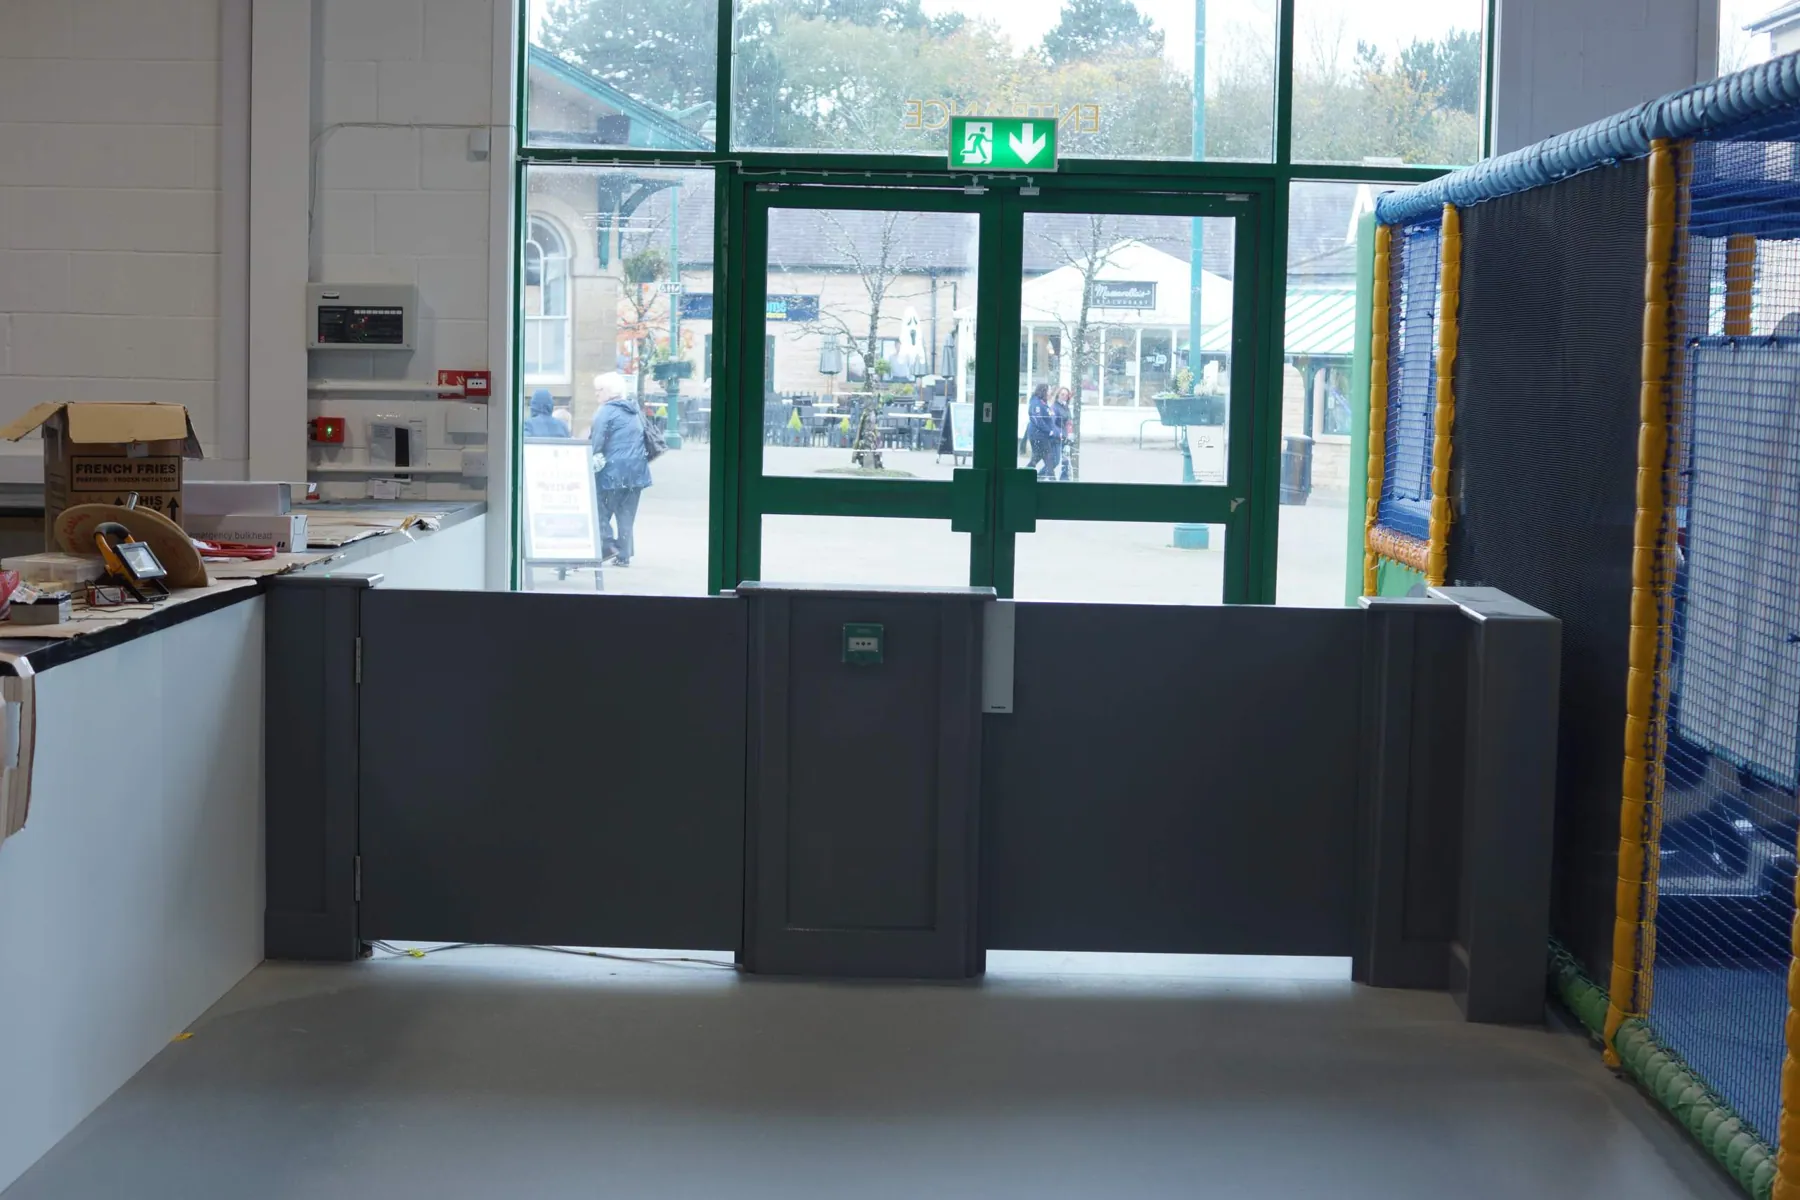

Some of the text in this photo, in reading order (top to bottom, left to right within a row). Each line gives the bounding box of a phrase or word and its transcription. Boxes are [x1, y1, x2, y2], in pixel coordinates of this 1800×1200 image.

[75, 463, 177, 475] FRENCH FRIES
[139, 495, 163, 506] HIS
[234, 530, 273, 541] bulkhead
